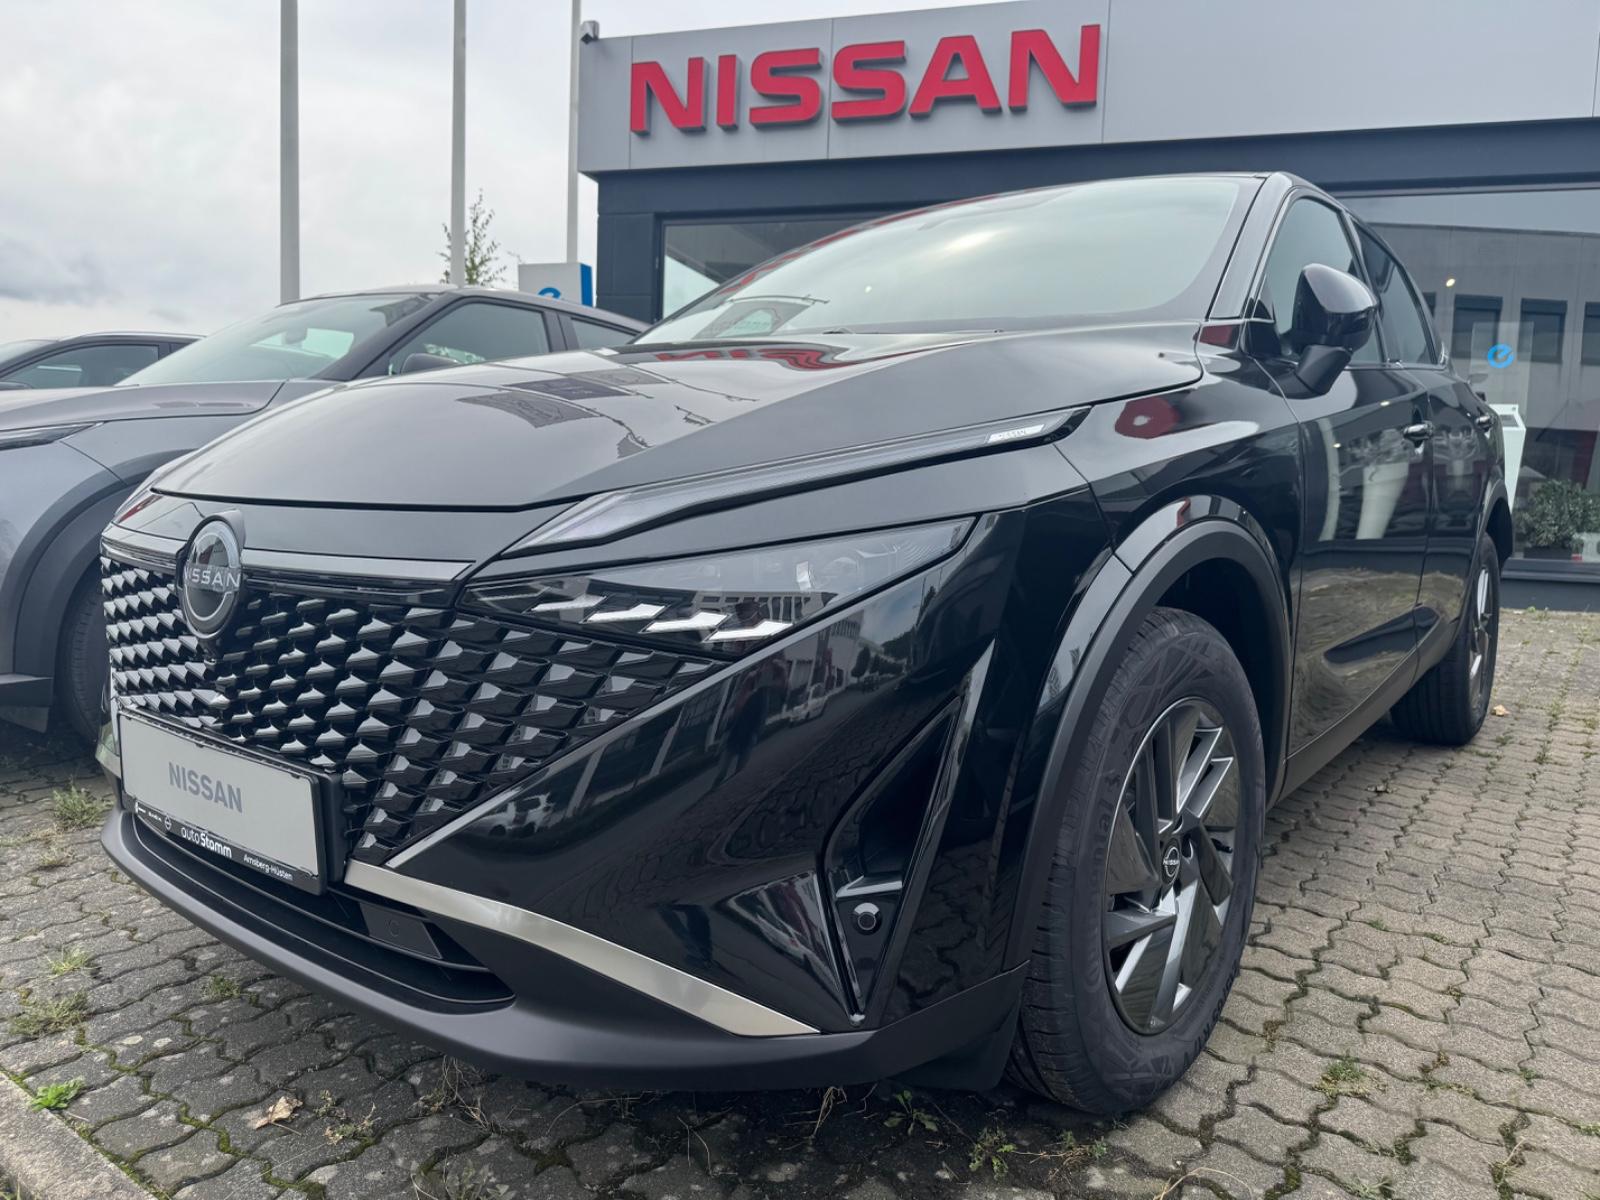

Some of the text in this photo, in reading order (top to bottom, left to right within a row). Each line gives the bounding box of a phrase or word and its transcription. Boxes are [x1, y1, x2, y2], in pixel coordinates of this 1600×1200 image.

[630, 24, 1101, 135] NISSAN
[184, 565, 241, 588] NISSAN
[168, 761, 243, 813] NISSAN
